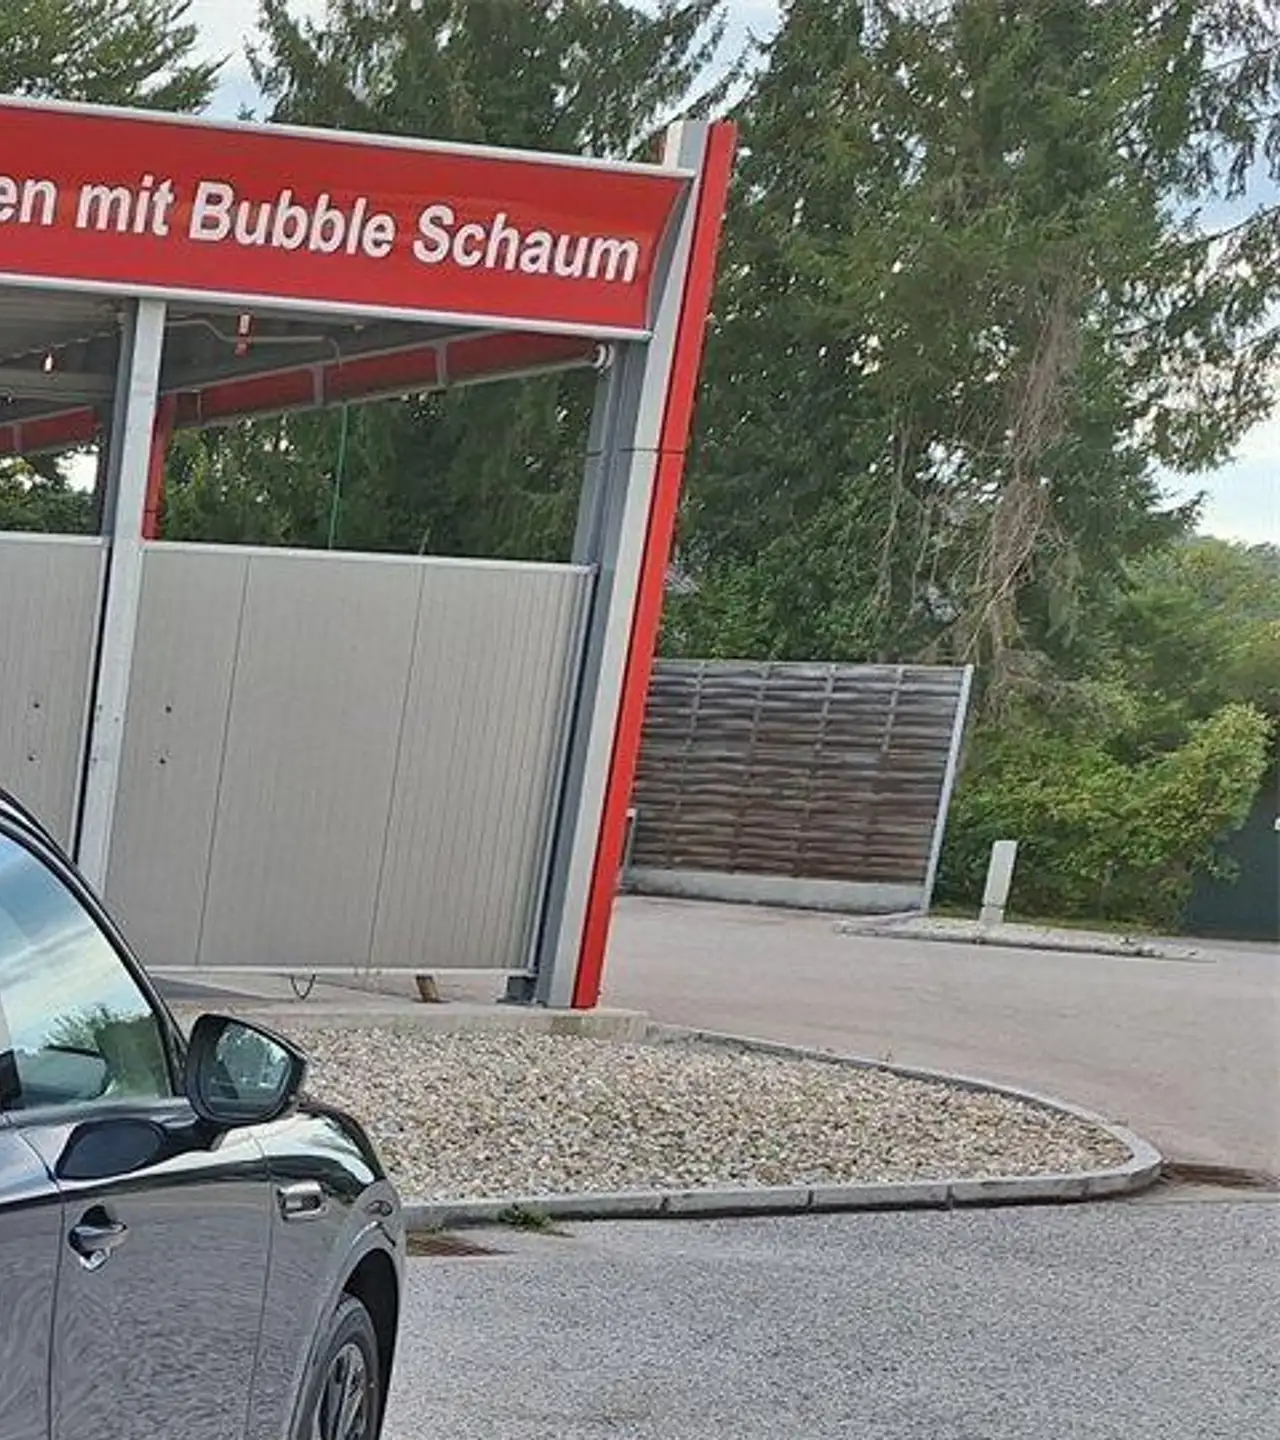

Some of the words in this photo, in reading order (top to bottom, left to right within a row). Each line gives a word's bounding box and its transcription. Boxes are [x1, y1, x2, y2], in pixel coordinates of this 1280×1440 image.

[74, 172, 173, 237] mit
[188, 179, 396, 260] Bubble
[412, 204, 640, 284] Schaum
